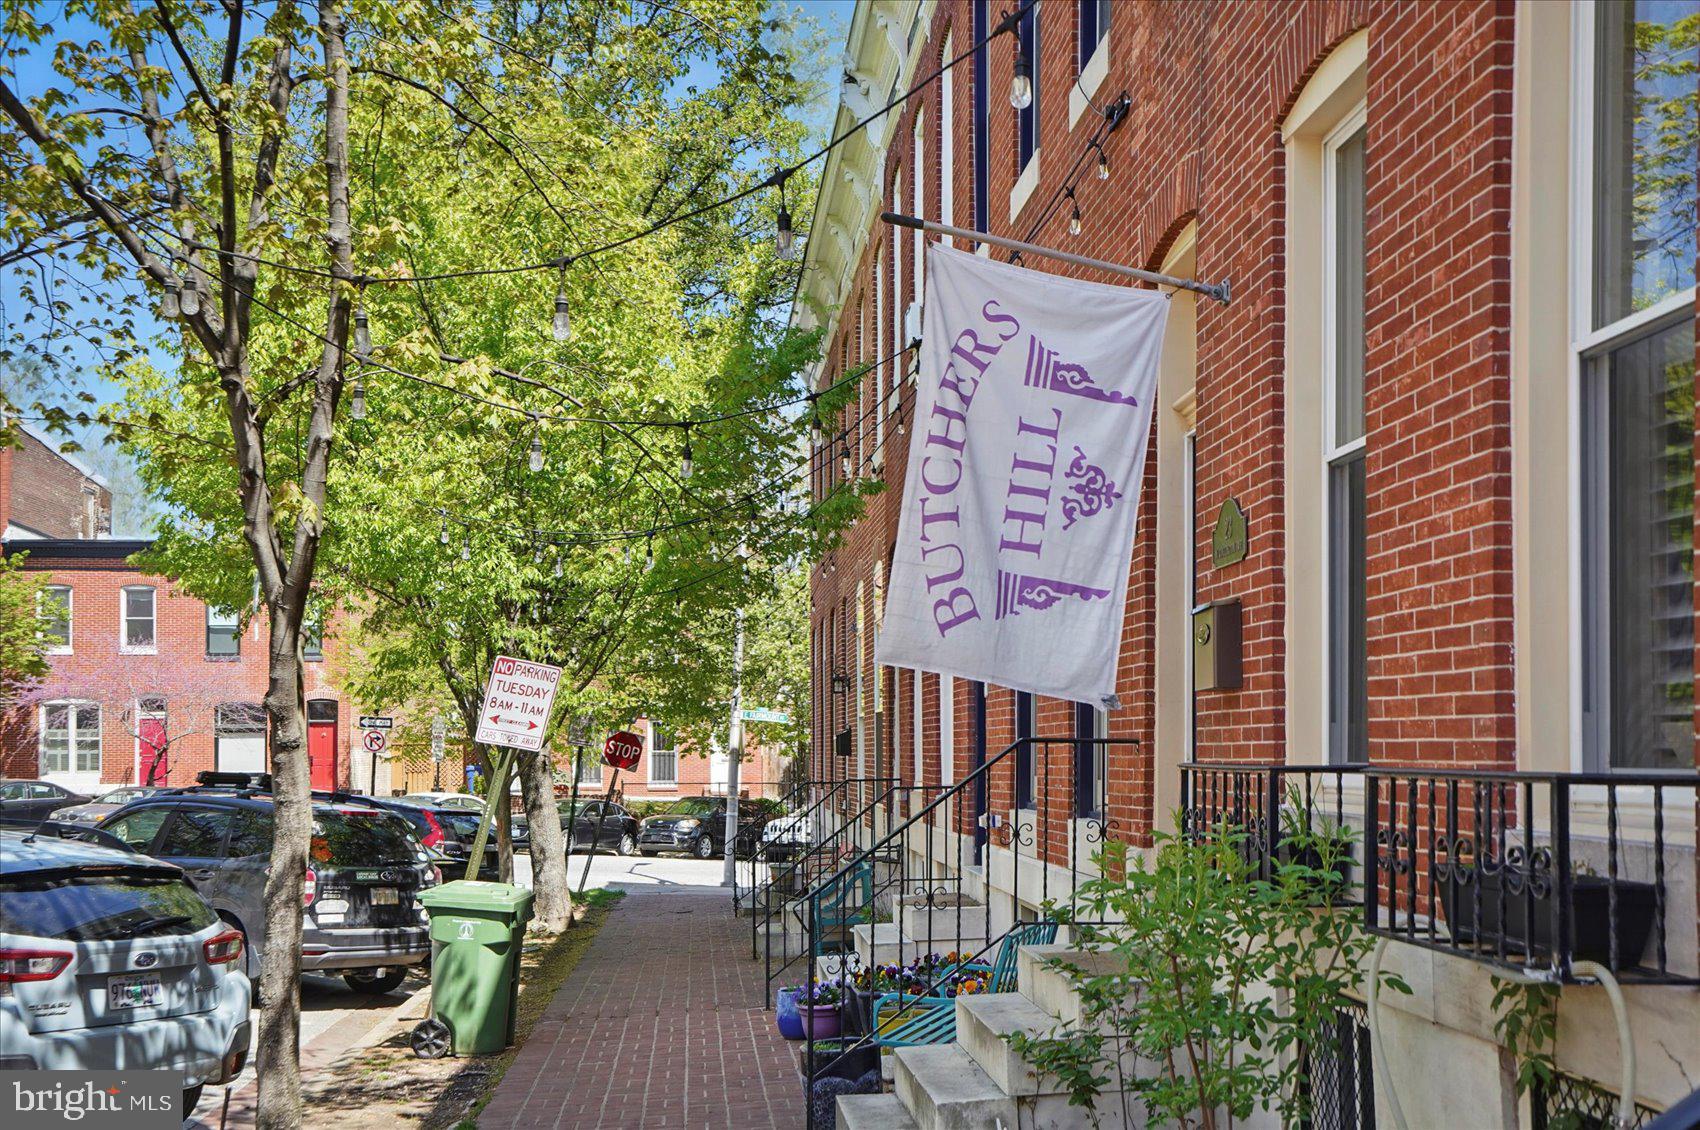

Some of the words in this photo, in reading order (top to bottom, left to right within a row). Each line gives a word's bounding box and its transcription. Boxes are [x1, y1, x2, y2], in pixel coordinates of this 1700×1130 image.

[919, 299, 1021, 639] BUTCHERS
[1000, 407, 1063, 560] HILL
[497, 660, 513, 675] NO
[514, 664, 557, 683] PARKING
[496, 679, 549, 700] TUESDAY
[480, 730, 496, 740] CARS
[500, 732, 519, 743] TOWED
[521, 736, 538, 747] AWAY
[606, 740, 640, 760] STOP
